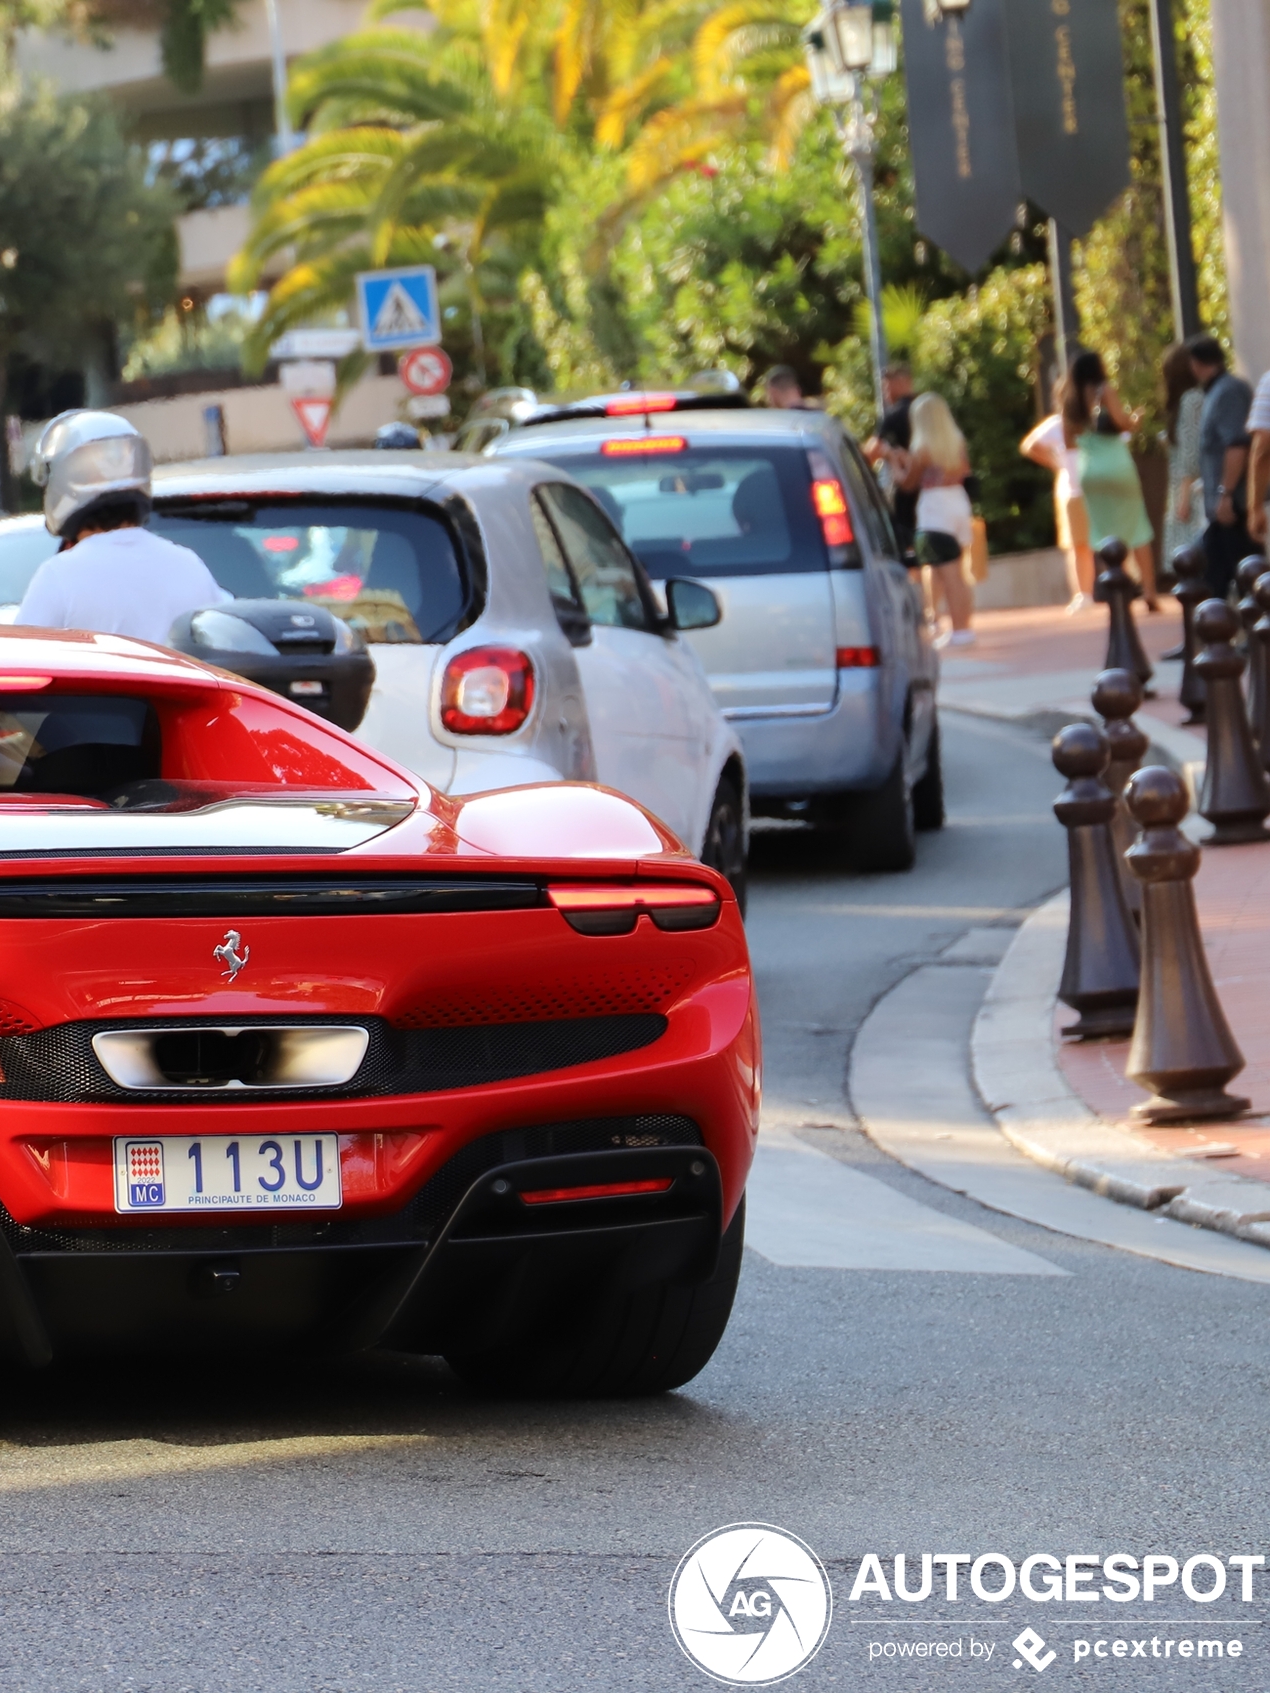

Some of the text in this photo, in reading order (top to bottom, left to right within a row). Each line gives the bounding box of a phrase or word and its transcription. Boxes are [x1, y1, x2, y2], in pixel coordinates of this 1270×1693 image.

[188, 1139, 324, 1192] 113U
[137, 1176, 156, 1184] 2022
[135, 1185, 159, 1202] MC
[188, 1193, 316, 1205] PRINCIPAUTE DE MONACO
